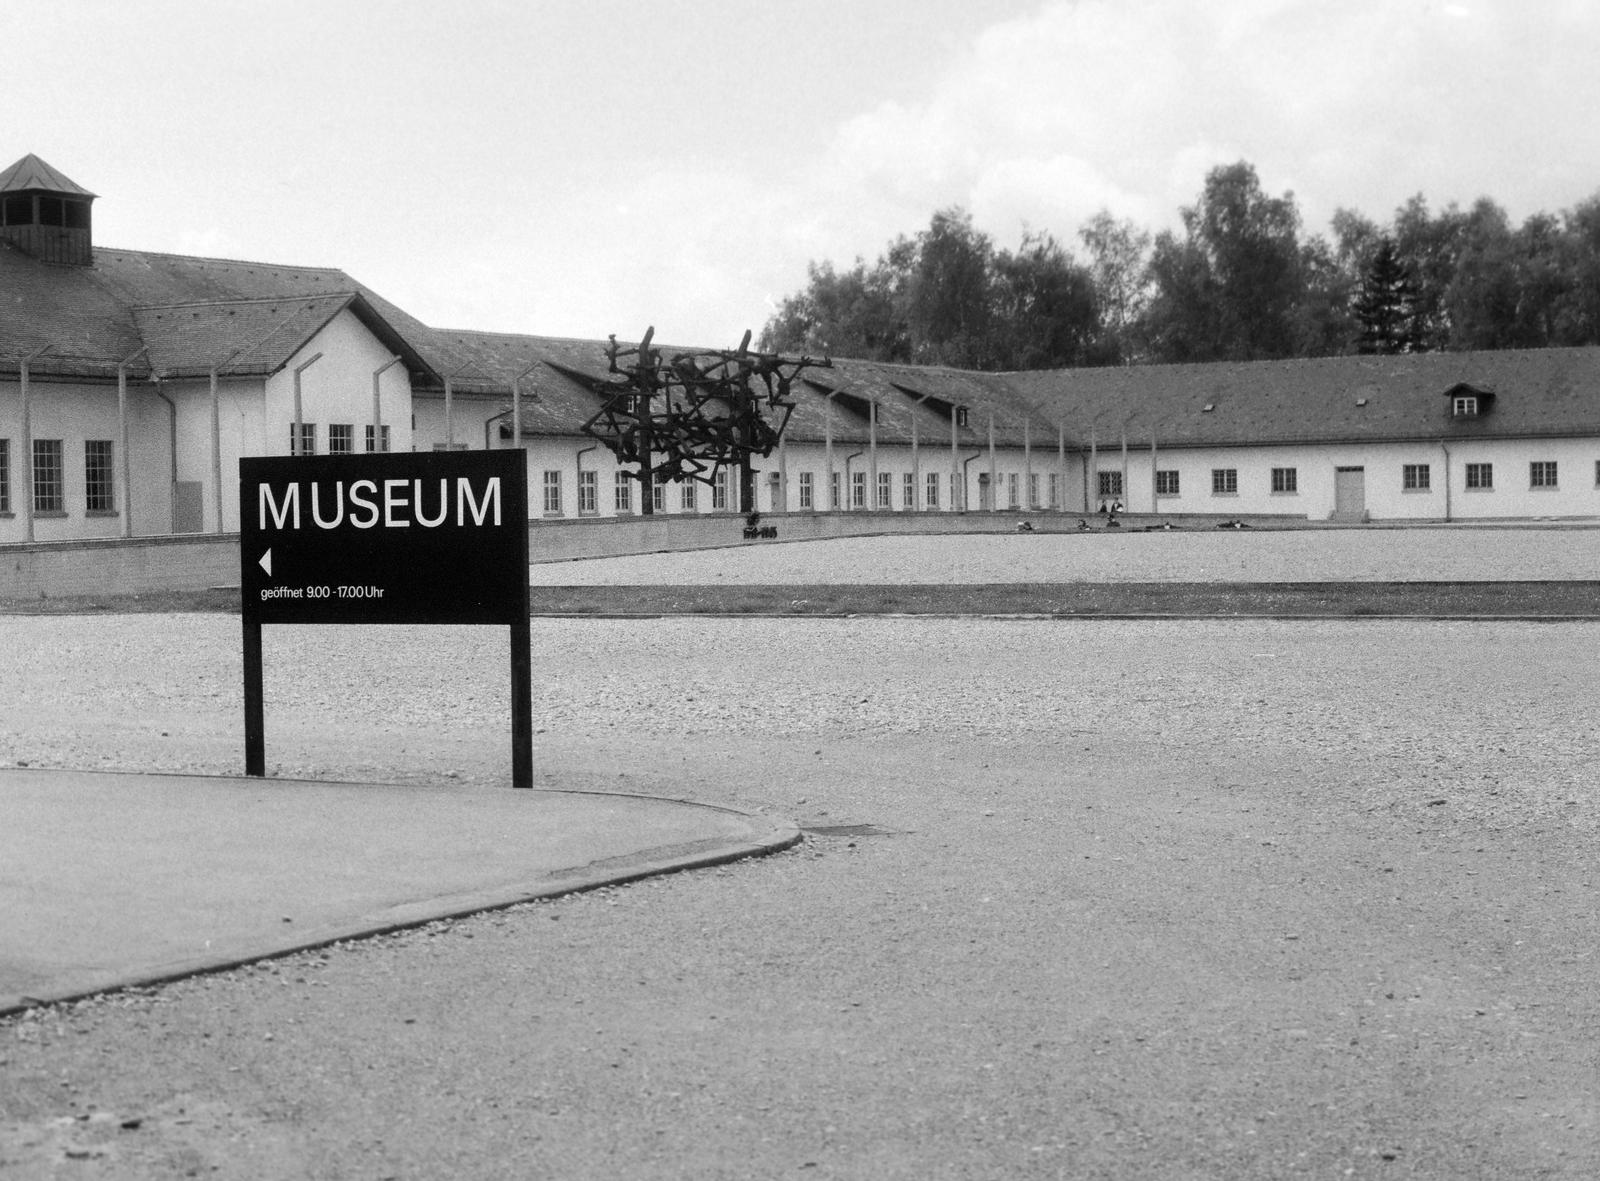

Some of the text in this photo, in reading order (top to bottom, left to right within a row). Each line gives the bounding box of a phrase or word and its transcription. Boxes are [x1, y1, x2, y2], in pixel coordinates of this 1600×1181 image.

[259, 477, 502, 530] MUSEUM
[260, 586, 303, 601] geöffnet
[306, 586, 331, 598] 9.00
[365, 586, 385, 598] Uhr
